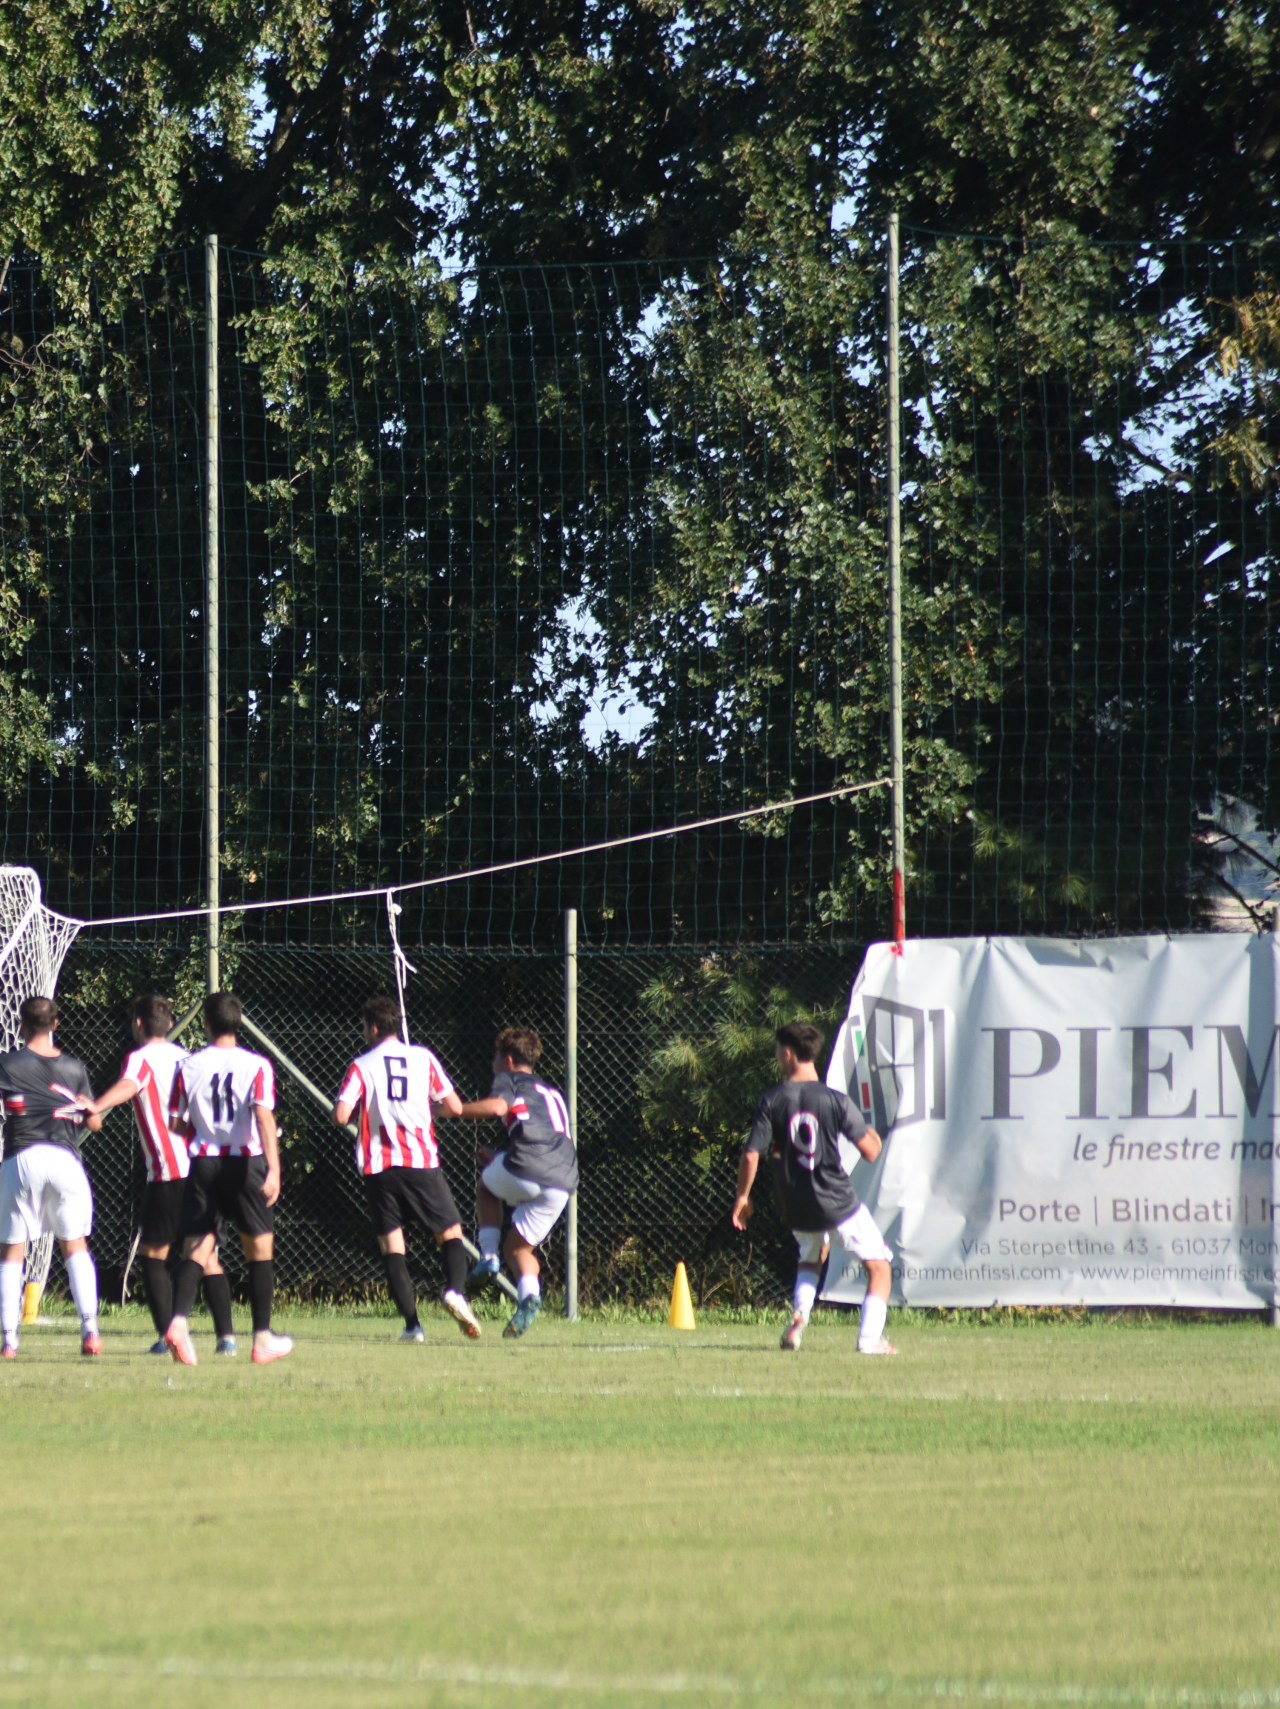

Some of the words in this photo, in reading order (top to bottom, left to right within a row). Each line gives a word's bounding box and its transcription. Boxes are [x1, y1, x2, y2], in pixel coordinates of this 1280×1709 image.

[383, 1056, 408, 1102] 6
[210, 1072, 234, 1122] 11
[789, 1111, 820, 1171] 9
[1073, 1133, 1098, 1161] le
[1102, 1134, 1221, 1168] finestre
[999, 1198, 1081, 1222] Porte
[1112, 1198, 1232, 1222] Blindati
[961, 1238, 990, 1256] Via
[998, 1238, 1115, 1258] Sterpettine
[1123, 1238, 1149, 1255] 43
[1171, 1238, 1231, 1255] 61037
[841, 1263, 1061, 1283] infpiemmeinfissi.com
